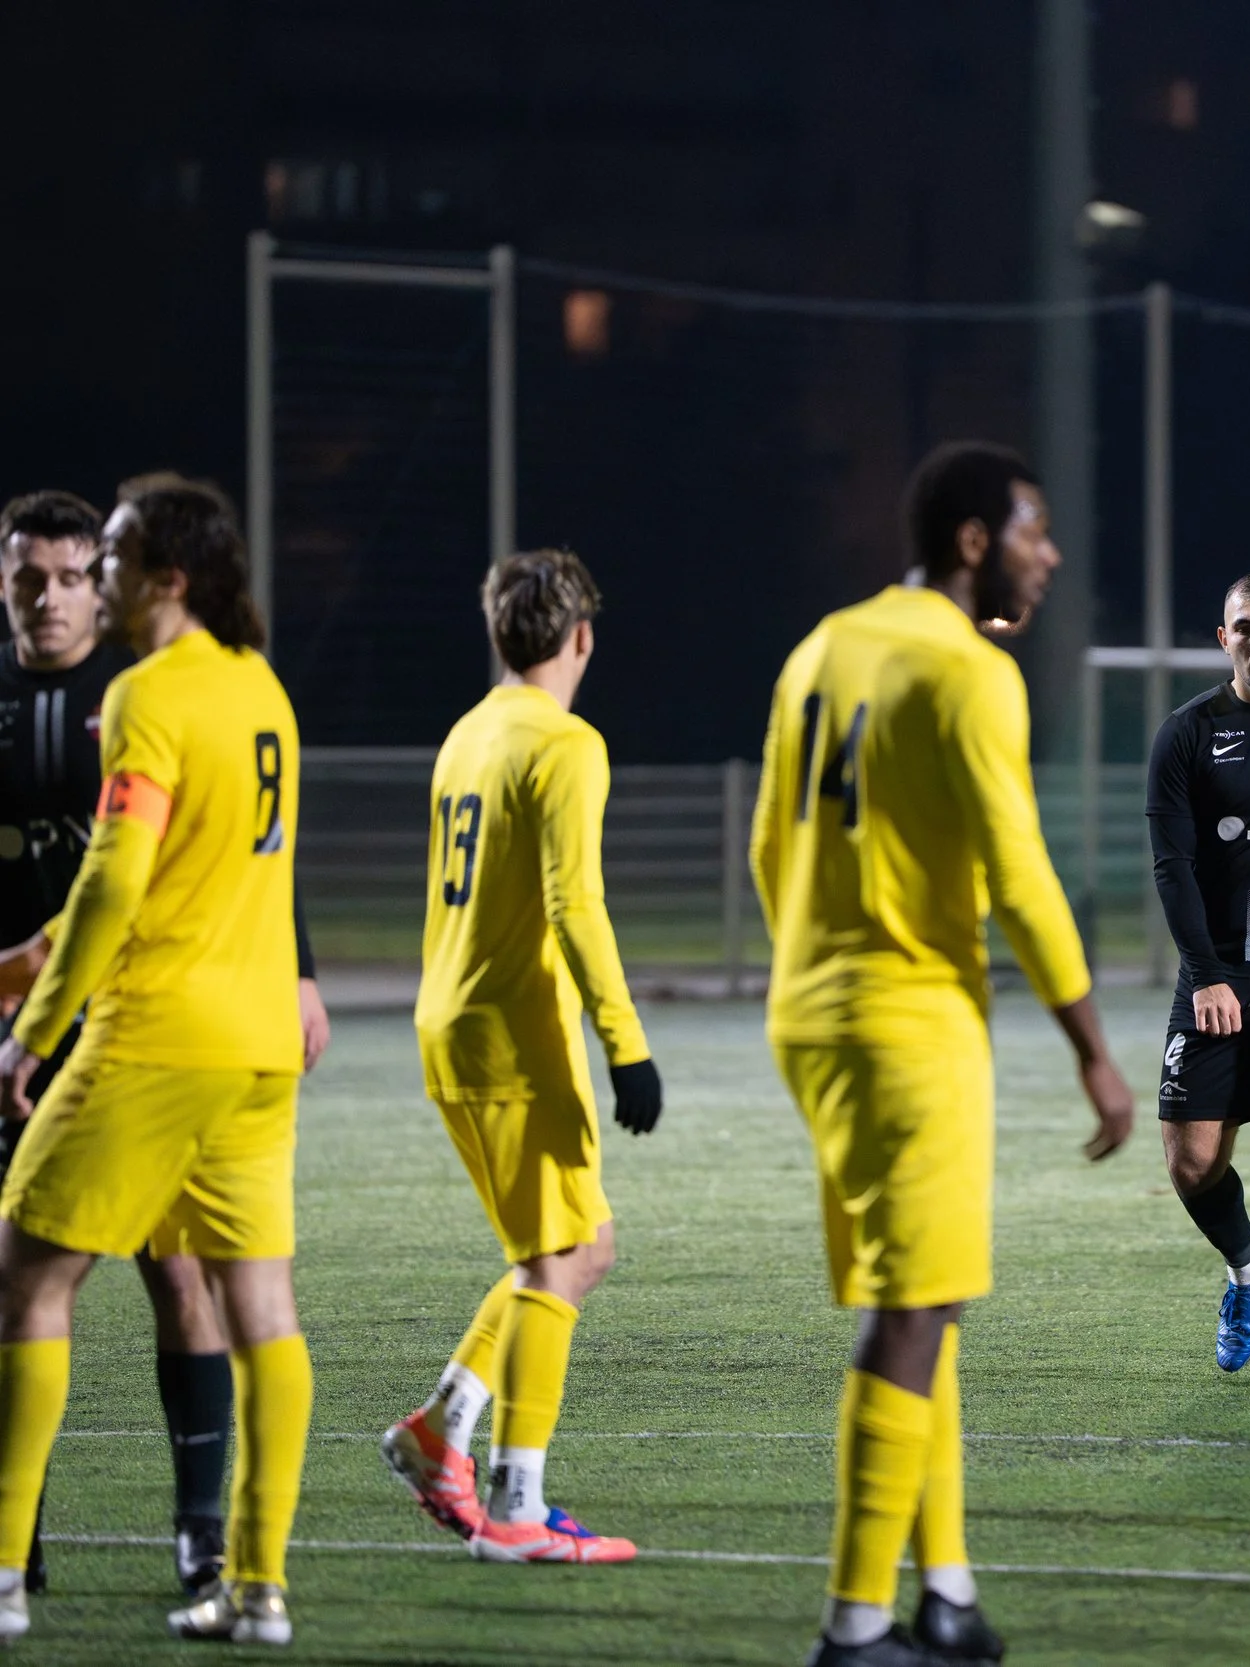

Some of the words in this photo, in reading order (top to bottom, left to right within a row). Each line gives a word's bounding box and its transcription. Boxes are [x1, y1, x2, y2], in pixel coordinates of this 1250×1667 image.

[799, 692, 867, 828] 14
[440, 793, 482, 906] 13
[1165, 1033, 1186, 1075] 4
